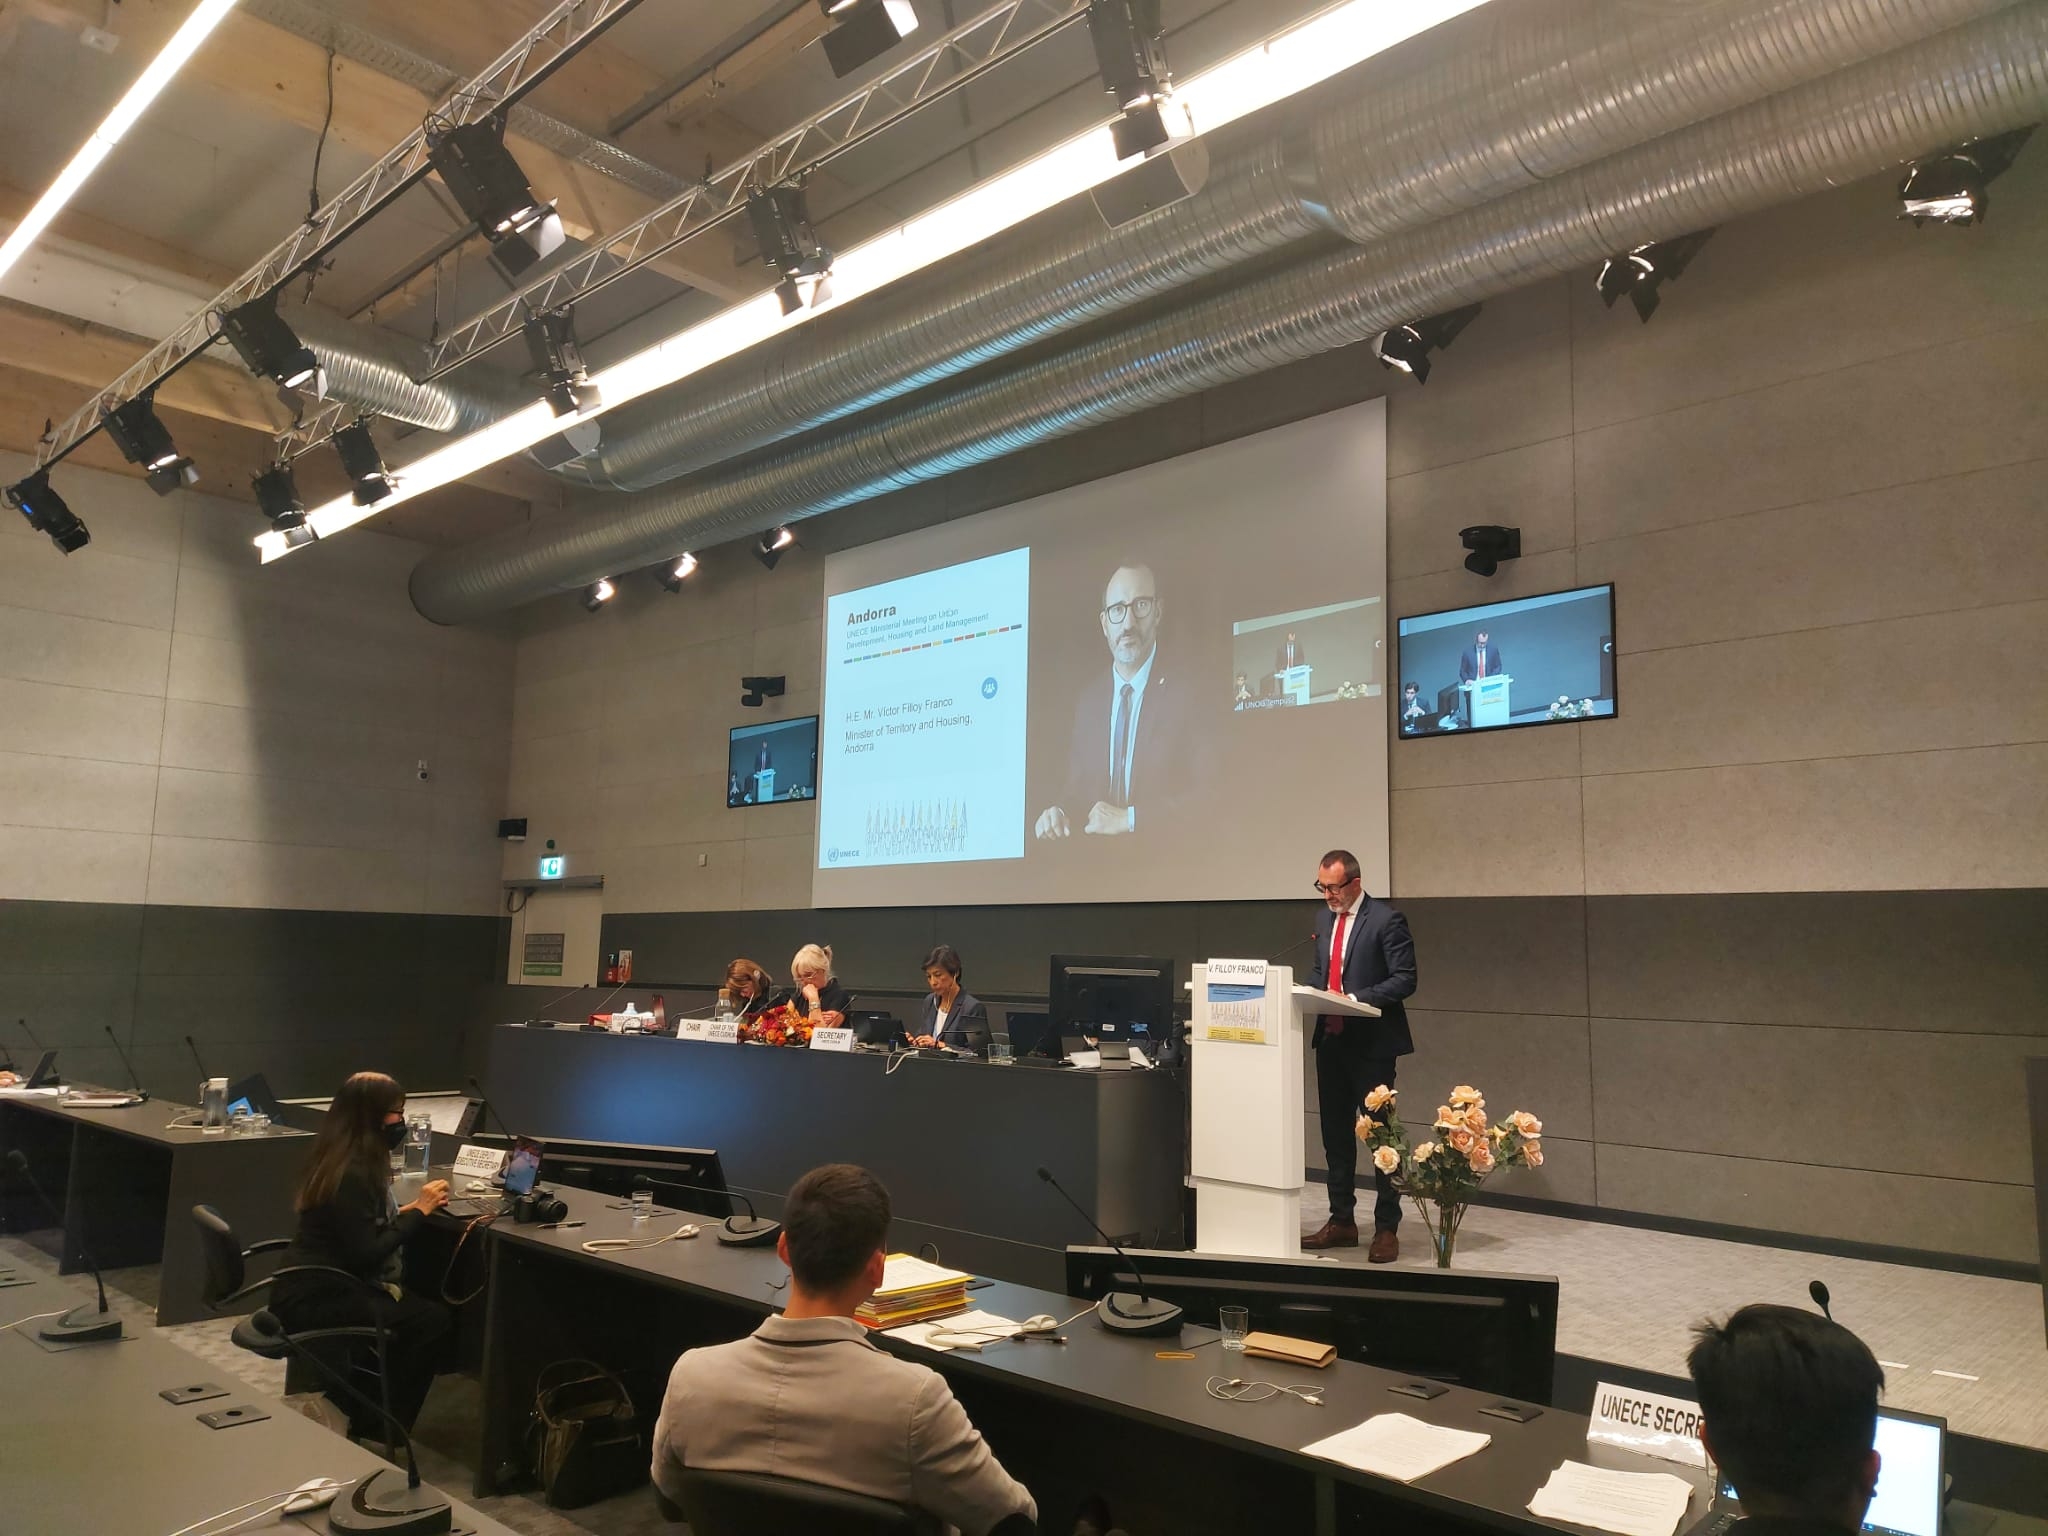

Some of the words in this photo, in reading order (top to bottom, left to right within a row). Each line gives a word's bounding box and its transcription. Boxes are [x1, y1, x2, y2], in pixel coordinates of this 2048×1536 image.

[847, 606, 897, 626] Andorra
[847, 628, 869, 638] UNECE
[871, 620, 901, 633] Ministerial
[903, 615, 928, 626] Meeting
[928, 613, 937, 621] on
[938, 608, 959, 618] Urban
[888, 629, 913, 640] Housing
[914, 626, 927, 635] and
[927, 623, 944, 632] Land
[946, 613, 989, 628] Management
[864, 710, 875, 720] Mr.
[902, 702, 923, 714] Filloy
[926, 698, 953, 710] Franco
[845, 730, 874, 742] Minister
[875, 726, 884, 737] of
[885, 722, 917, 736] Territory
[918, 719, 934, 730] and
[845, 743, 874, 754] Andorra
[840, 850, 860, 858] UNECE
[1208, 964, 1214, 973] V.
[1215, 965, 1237, 974] FILLOY
[1238, 965, 1264, 974] FRANCO
[686, 1023, 701, 1032] CHAIR
[816, 1031, 847, 1040] SECRETARY
[1601, 1393, 1652, 1428] UNECE
